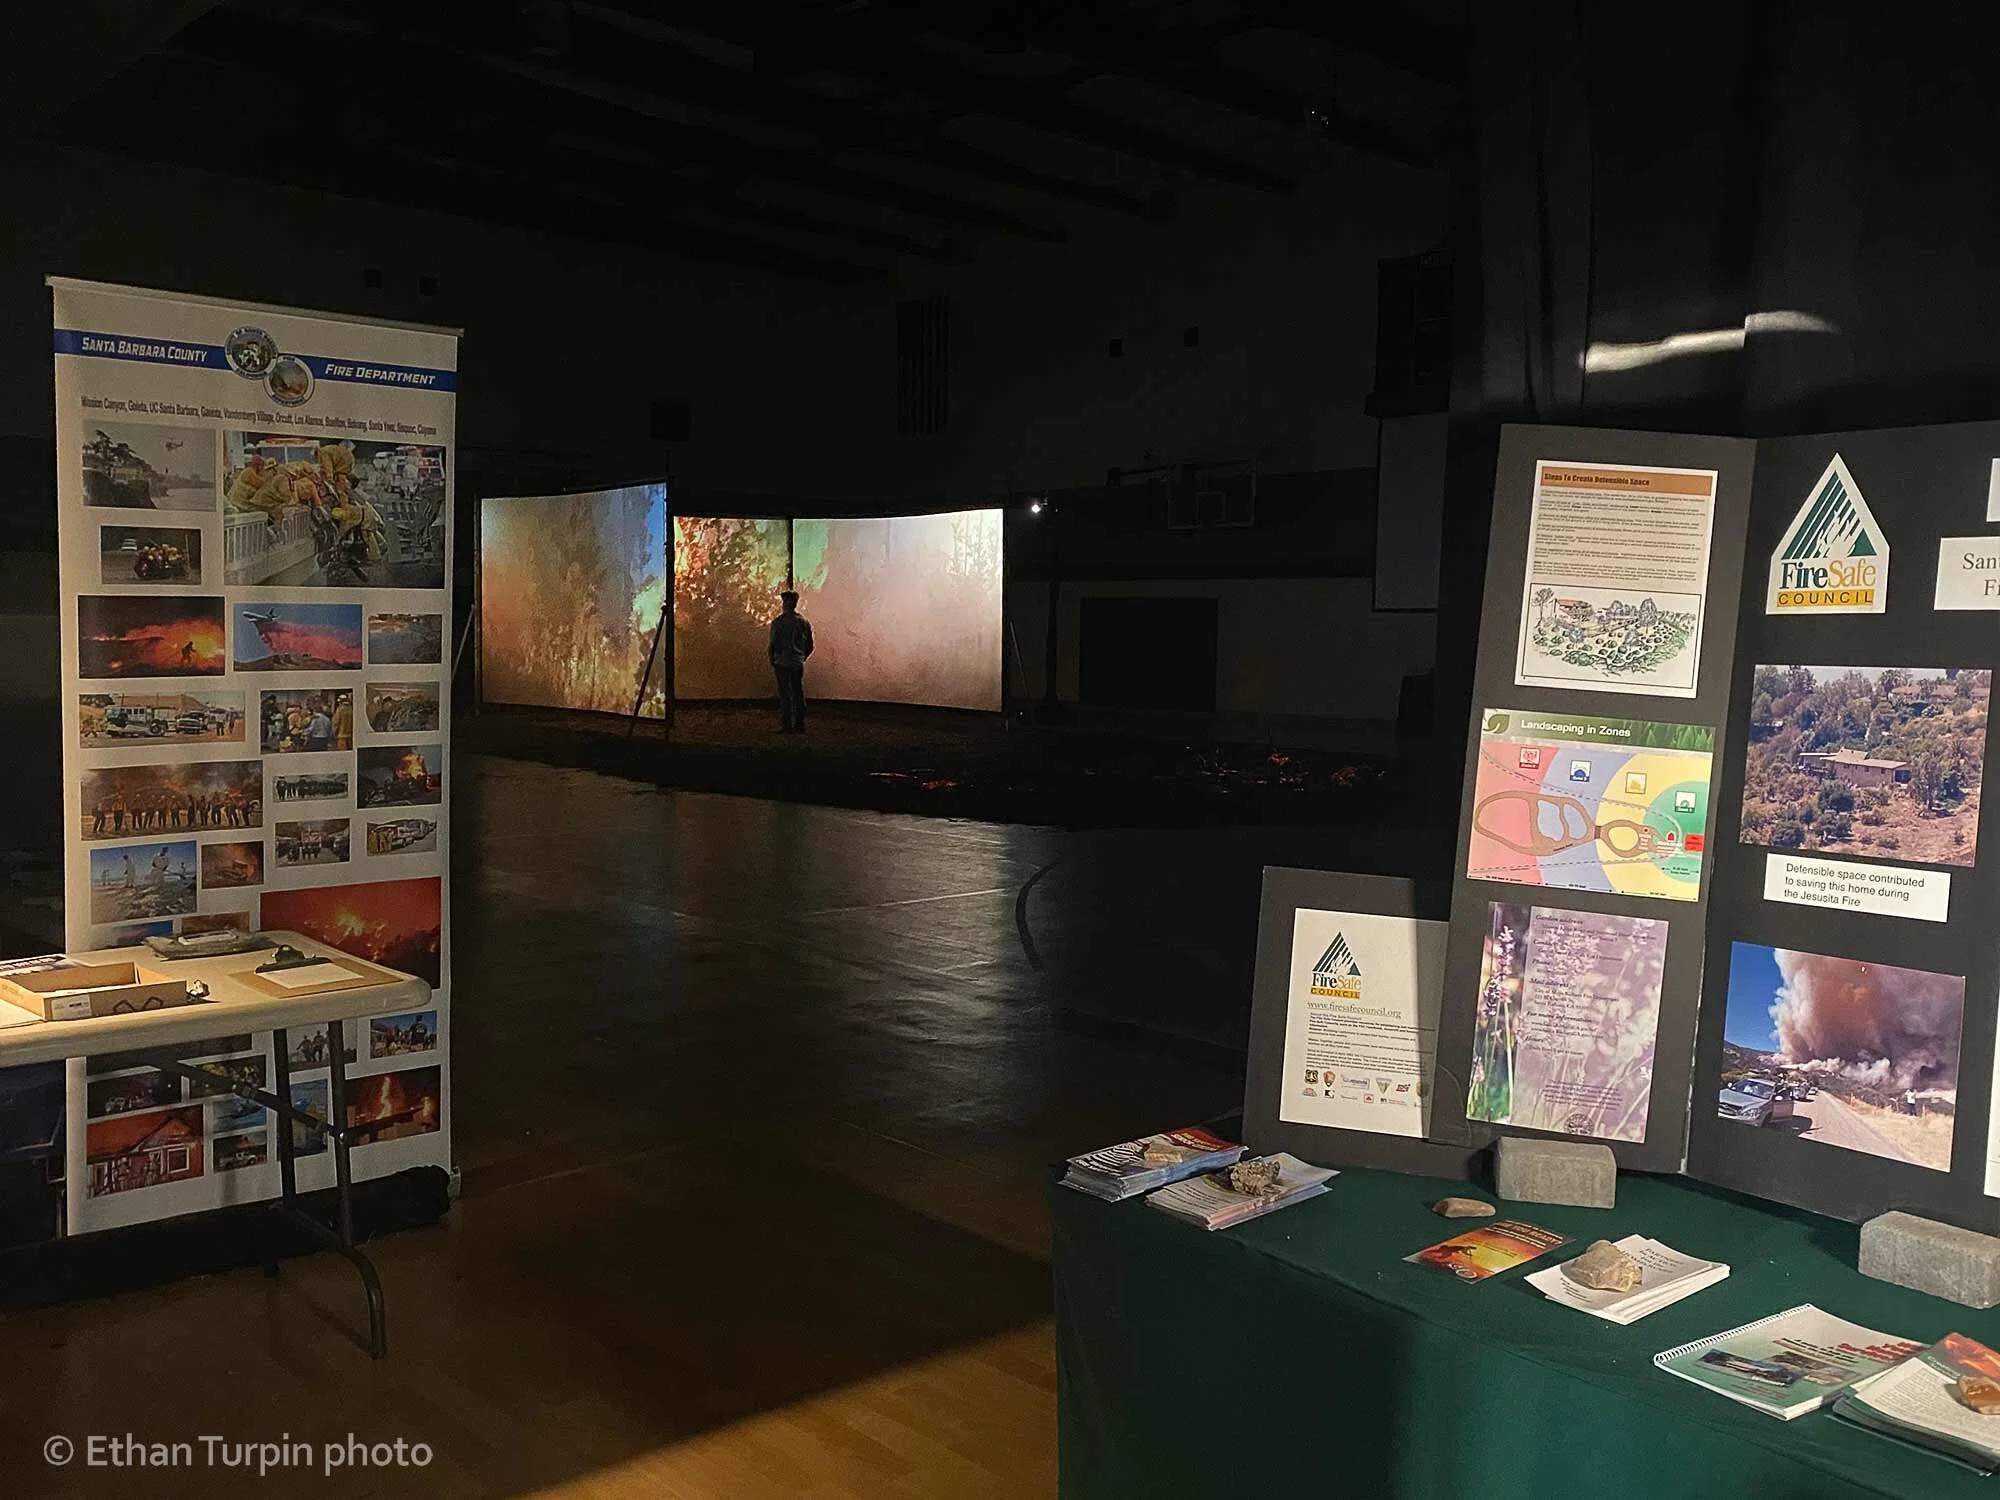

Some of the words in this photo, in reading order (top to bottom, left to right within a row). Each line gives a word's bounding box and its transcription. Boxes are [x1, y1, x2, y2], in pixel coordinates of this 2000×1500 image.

[82, 337, 115, 353] SANTA
[118, 340, 165, 359] BARBARA
[167, 346, 208, 362] COUNTY
[325, 364, 354, 377] FIRE
[355, 367, 436, 385] DEPARTMENT
[1963, 552, 2000, 570] San
[1779, 591, 1873, 605] COUNCIL
[1521, 719, 1584, 735] Landscaping
[1587, 725, 1596, 734] in
[1599, 725, 1631, 737] Zones
[1786, 863, 1835, 878] Defensible
[1837, 870, 1866, 881] space
[1869, 874, 1925, 888] contributed
[1784, 889, 1799, 899] the
[1800, 891, 1839, 904] Jesusita
[1842, 895, 1861, 907] Fire
[1785, 876, 1794, 886] to
[1796, 878, 1826, 892] saving
[1829, 881, 1845, 892] this
[1848, 883, 1876, 896] home
[1878, 886, 1910, 902] during
[1311, 987, 1360, 999] COUNCIL
